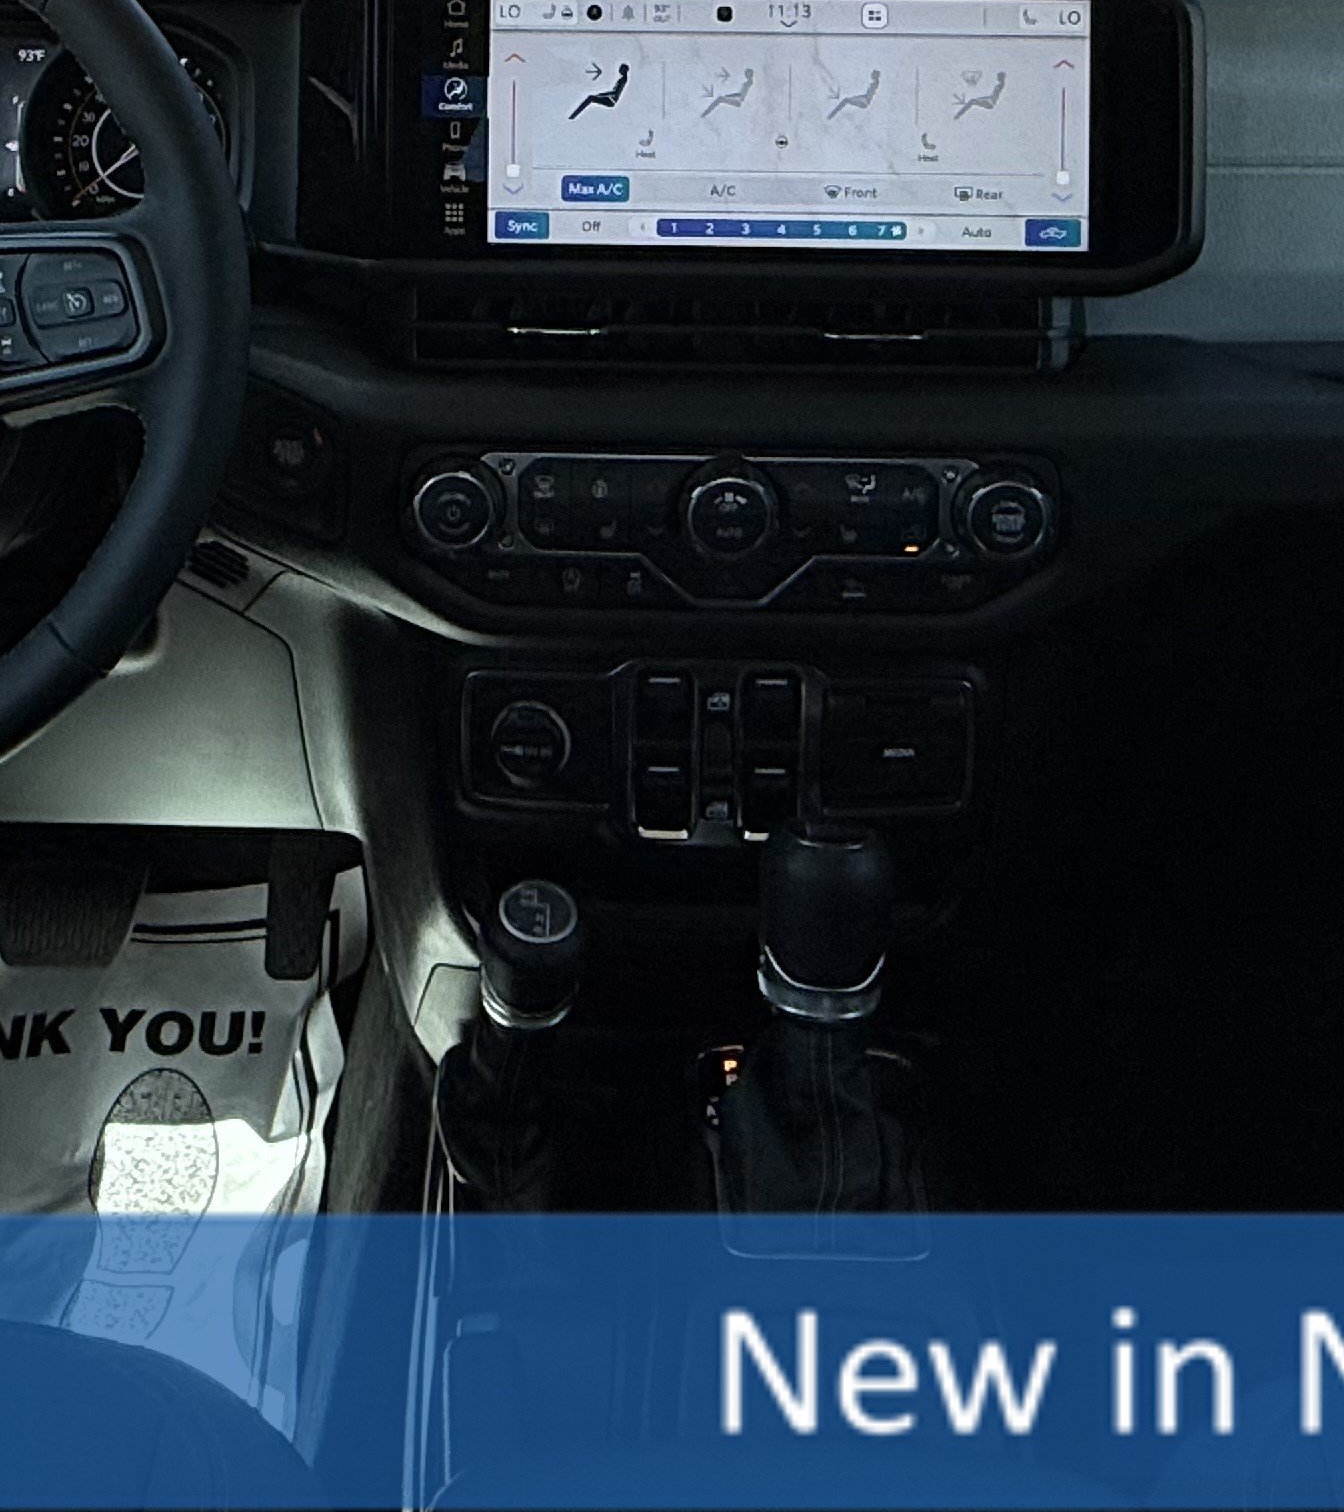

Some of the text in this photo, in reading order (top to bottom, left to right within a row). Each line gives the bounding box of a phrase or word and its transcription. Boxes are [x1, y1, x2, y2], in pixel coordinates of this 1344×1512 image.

[768, 4, 812, 19] 11:13
[1058, 9, 1082, 25] LO
[567, 182, 624, 196] Max A/C
[709, 184, 737, 197] A/C
[844, 186, 878, 199] Front
[975, 188, 1003, 200] Rear
[506, 219, 539, 234] Sync
[581, 220, 602, 233] Off
[670, 222, 885, 237] 1 2 3 4 5 6 7
[962, 226, 993, 238] Auto
[99, 1006, 266, 1057] YOU!
